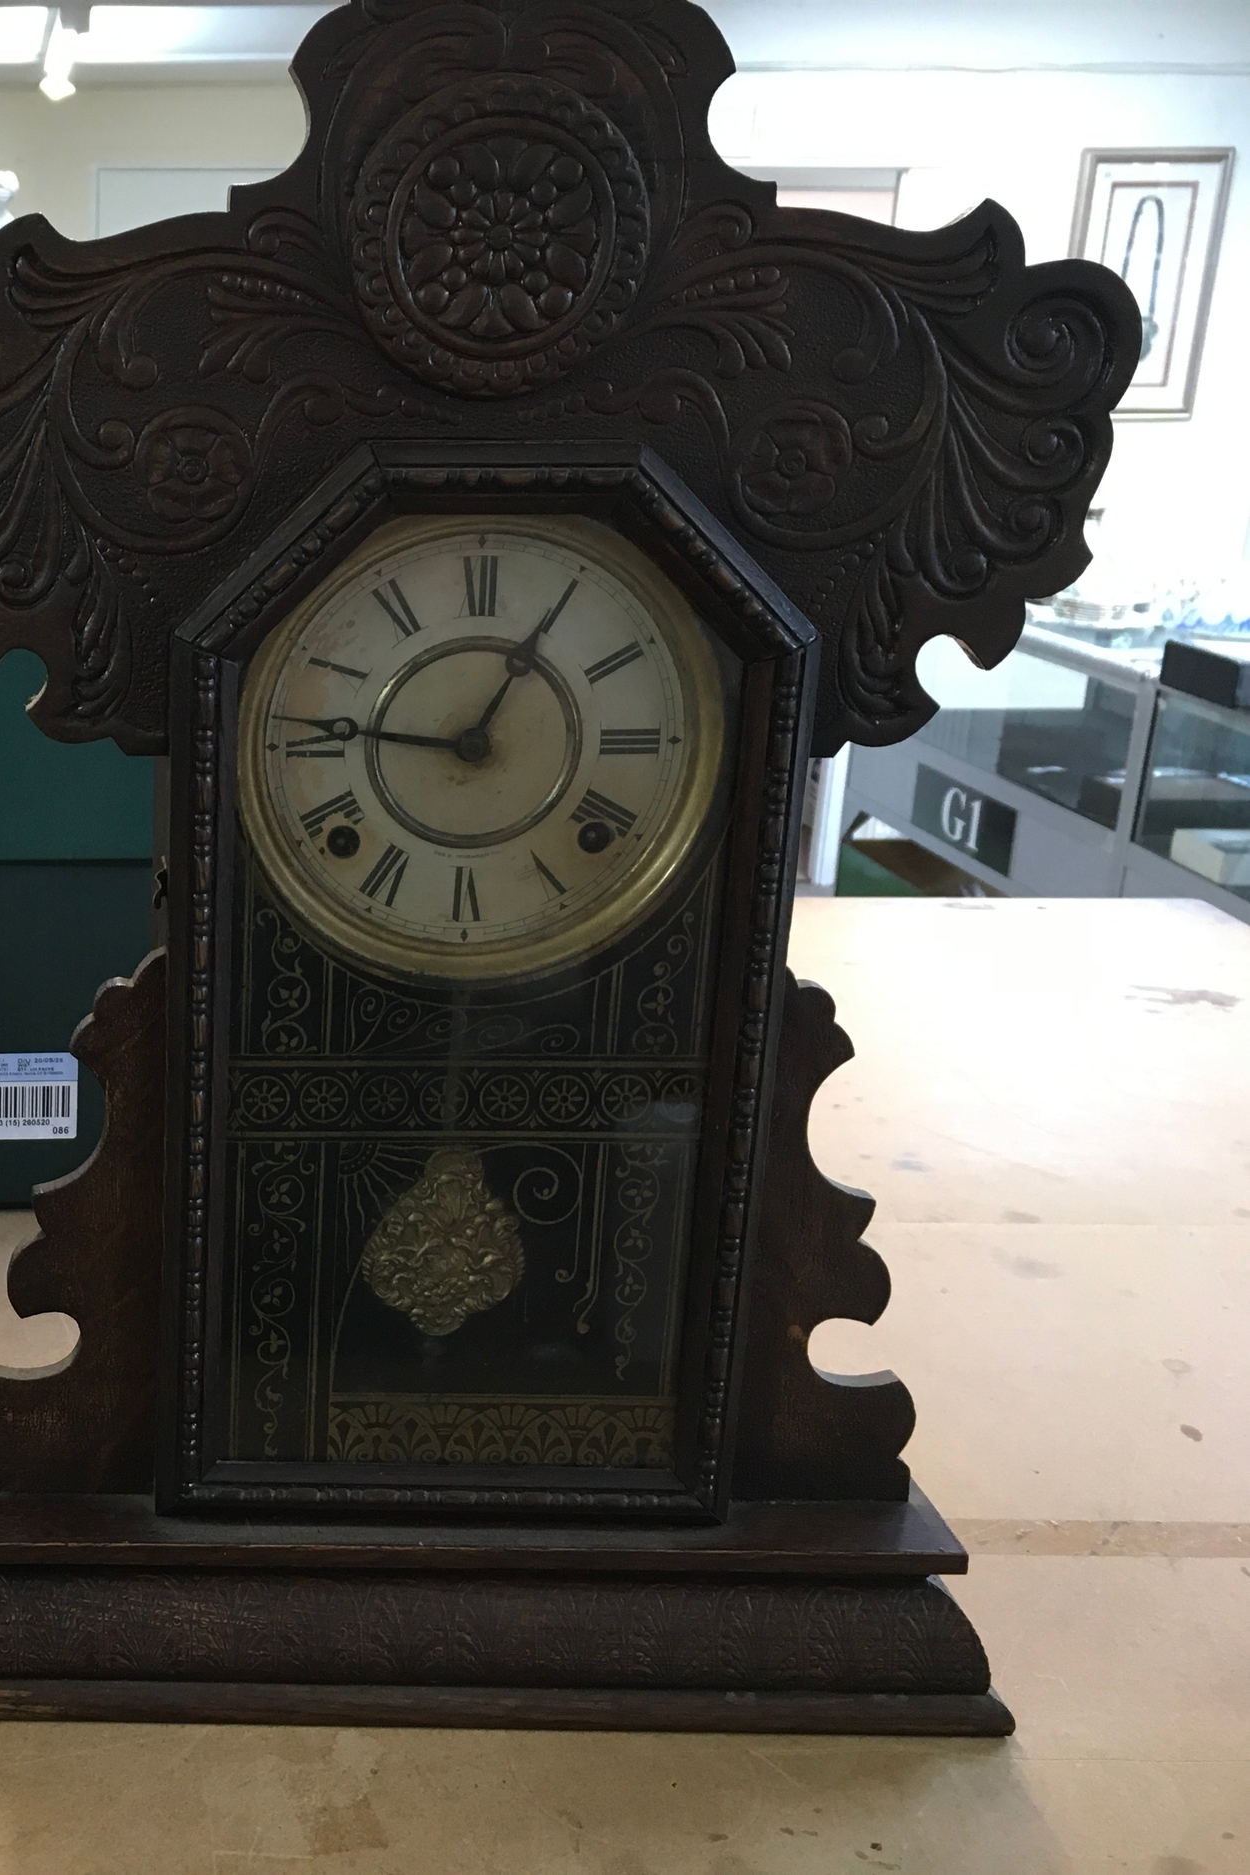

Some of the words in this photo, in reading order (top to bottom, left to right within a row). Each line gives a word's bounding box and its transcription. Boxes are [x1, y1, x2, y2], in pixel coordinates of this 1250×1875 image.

[942, 787, 982, 852] G1
[5, 1119, 20, 1127] (15)
[52, 1126, 69, 1134] 086
